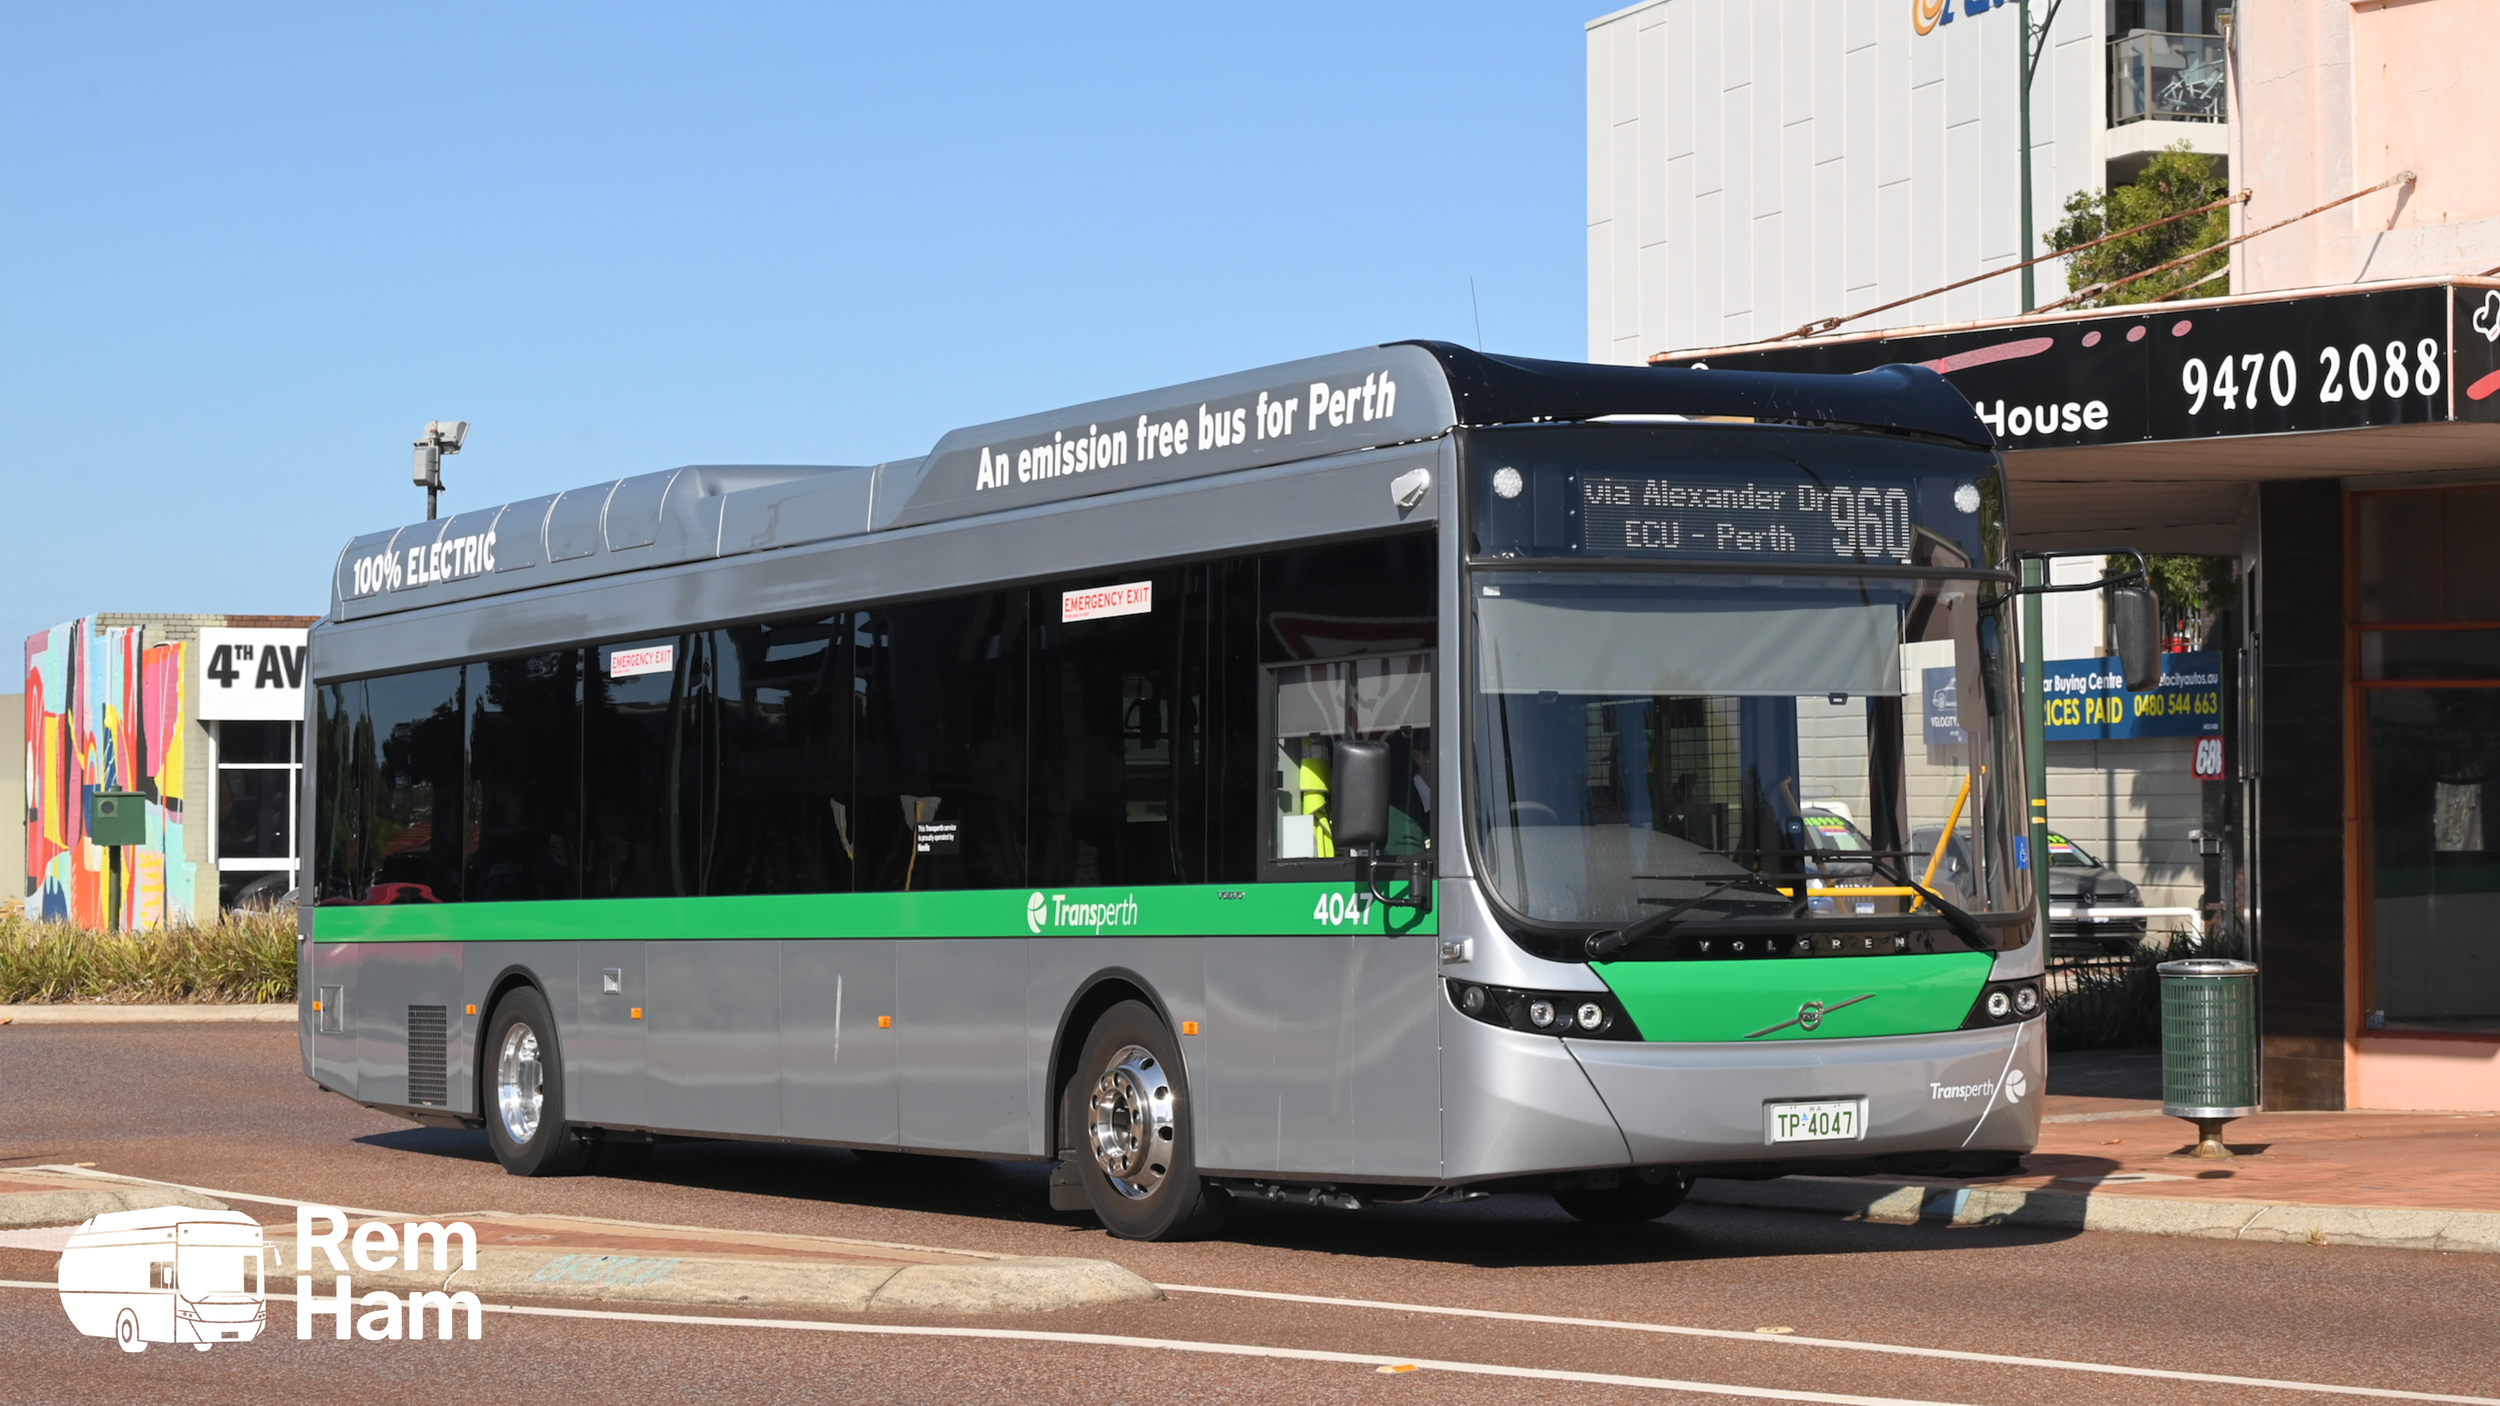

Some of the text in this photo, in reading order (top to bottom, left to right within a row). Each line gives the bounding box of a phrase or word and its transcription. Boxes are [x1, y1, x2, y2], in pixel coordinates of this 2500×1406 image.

[2182, 337, 2441, 416] 9470 2088
[975, 370, 1396, 491] An emission free bus for Perth
[1975, 399, 2109, 437] House
[1586, 477, 1910, 558] via Alexander Dr 960
[1625, 520, 1679, 549] ECU
[1717, 523, 1796, 552] Perth
[353, 530, 497, 596] 100% ELECTRIC
[1064, 586, 1149, 613] EMERGENCY EXIT
[207, 644, 254, 689] 4TH
[612, 649, 671, 670] EMERGENCY EXIT
[2043, 679, 2053, 692] ar
[2054, 674, 2087, 695] Buying
[2088, 671, 2123, 690] Centre
[2159, 672, 2218, 688] elocityautos.au
[2043, 696, 2124, 726] ICES PAID
[2134, 692, 2218, 717] 0480 544 663
[1052, 893, 1138, 935] Transperth
[1313, 892, 1373, 926] 4047
[1699, 936, 1906, 952] VOLGREN
[1929, 1079, 1995, 1102] Transperth
